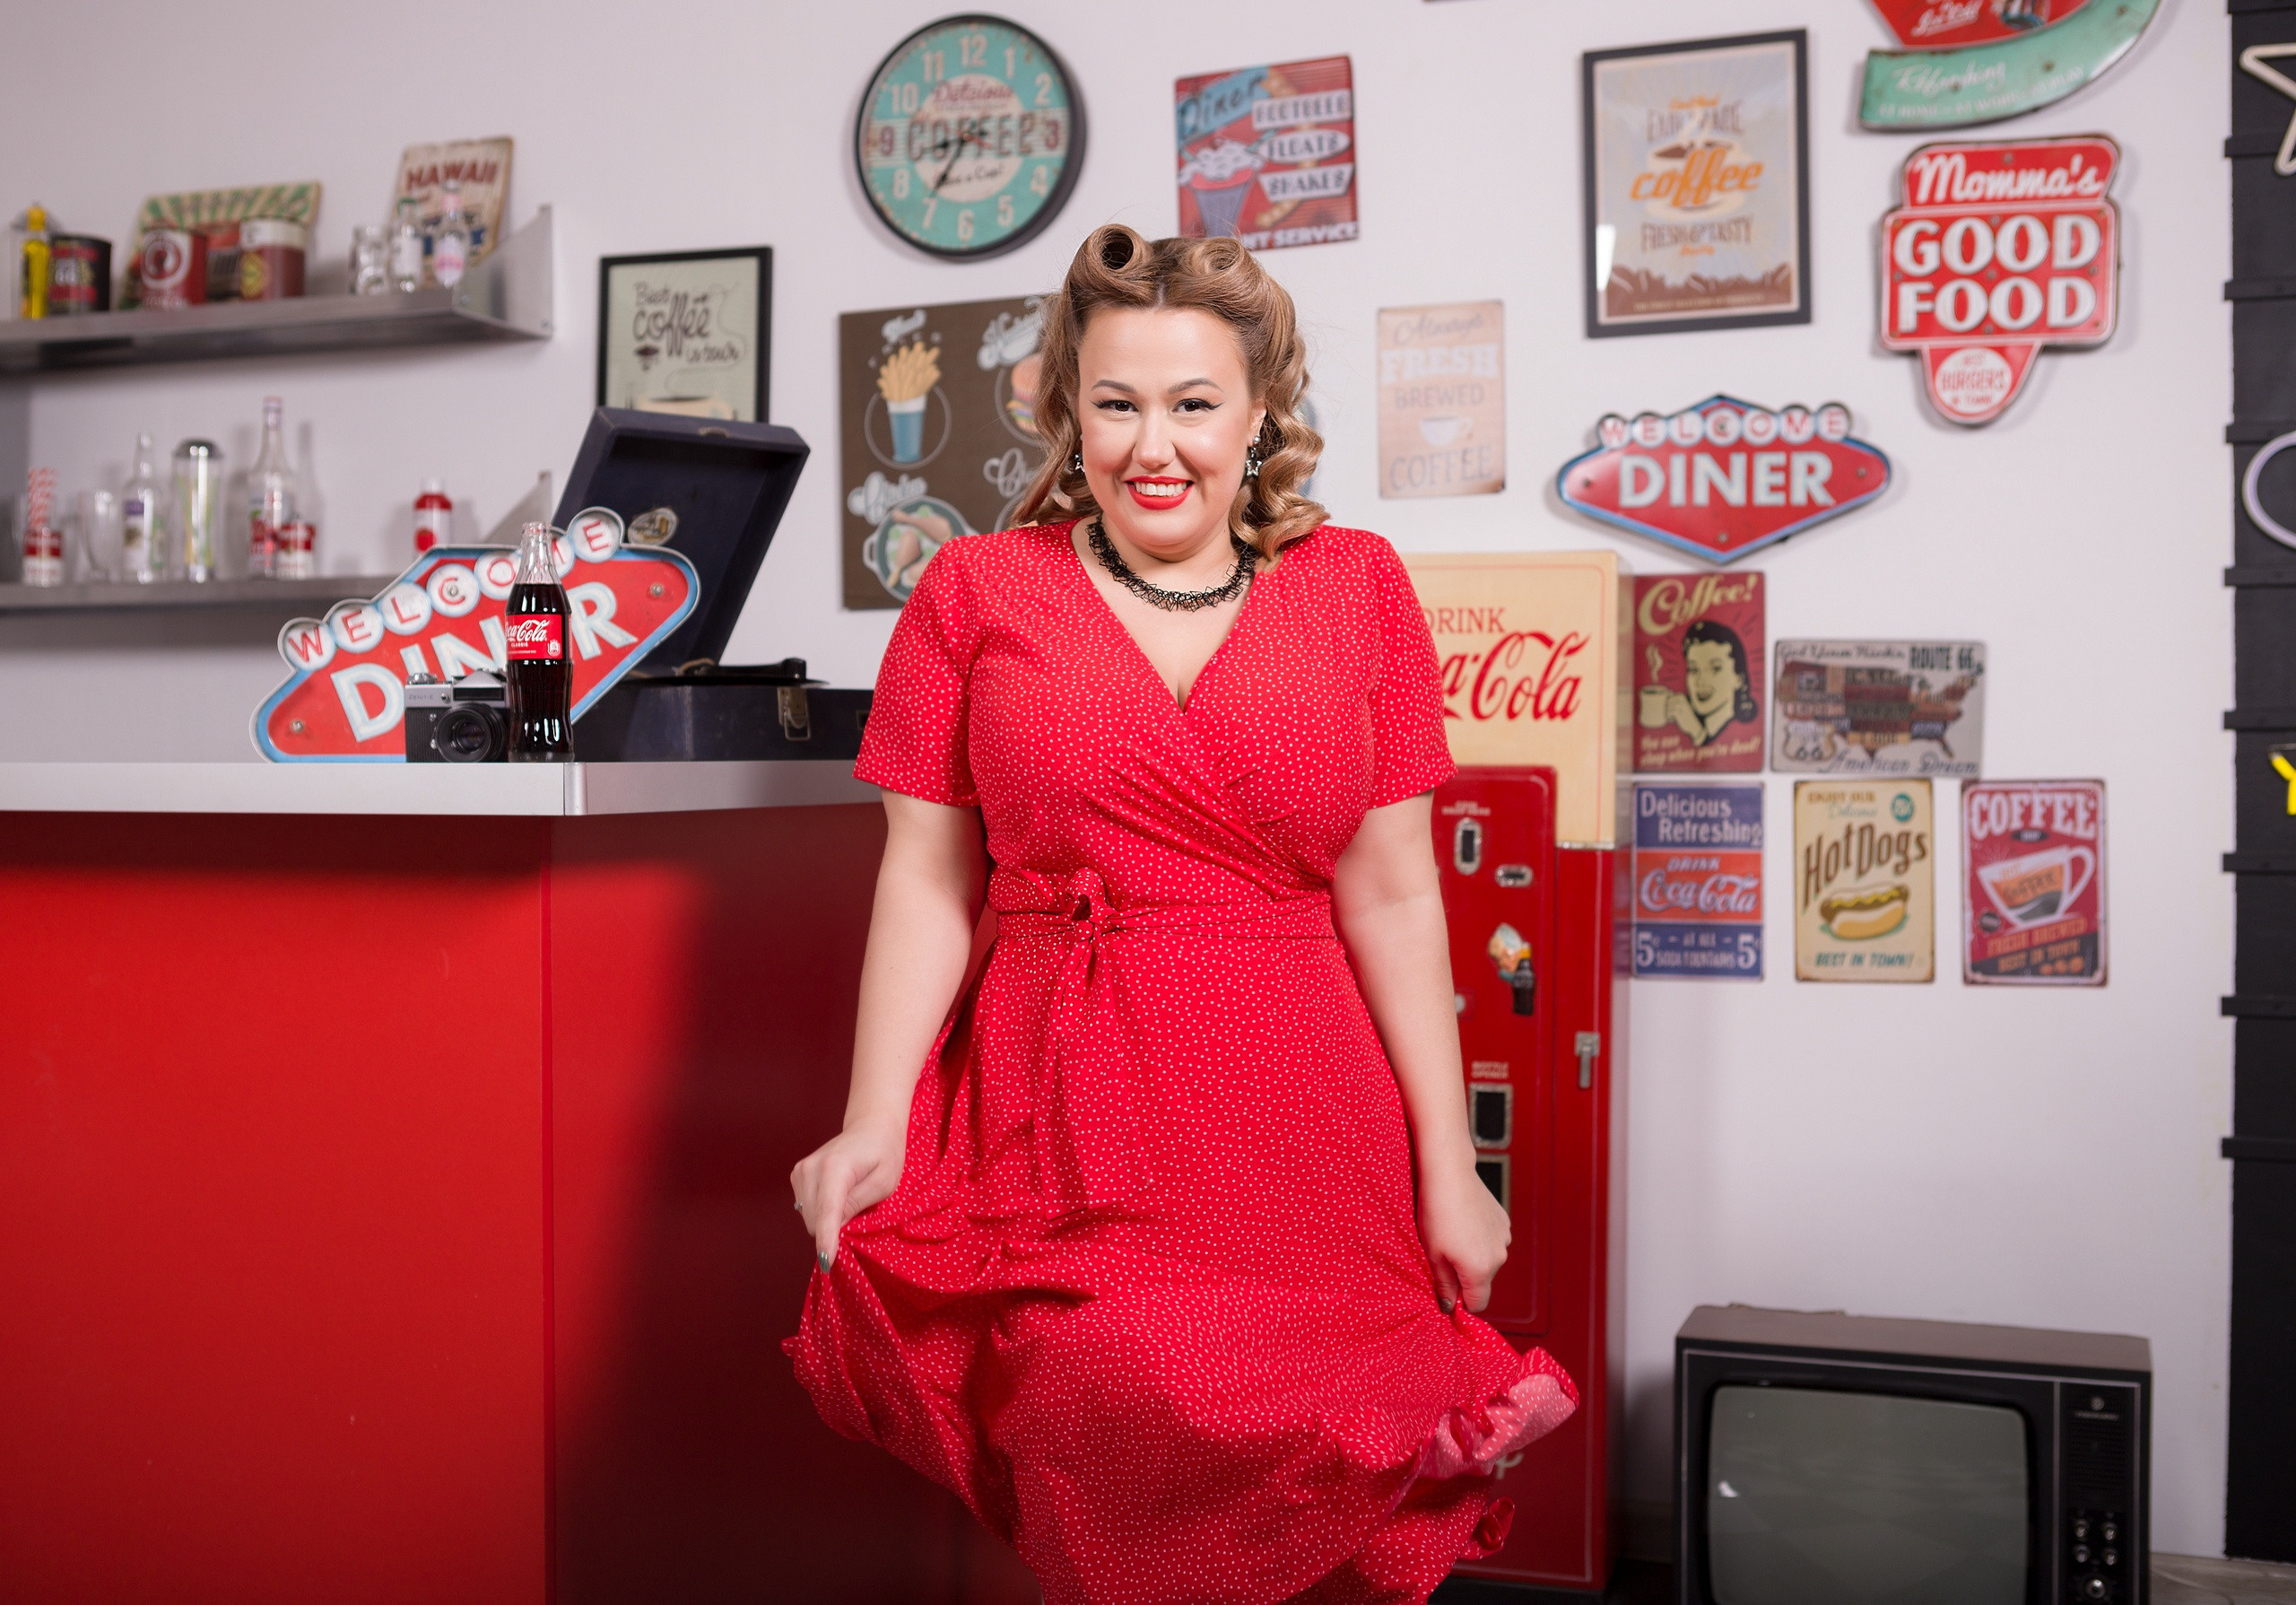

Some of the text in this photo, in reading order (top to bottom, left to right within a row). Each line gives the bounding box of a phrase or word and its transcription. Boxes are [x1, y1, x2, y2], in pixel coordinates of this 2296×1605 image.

[922, 50, 944, 82] 11
[960, 34, 987, 68] 12
[1004, 47, 1016, 79] 1
[891, 83, 918, 115] 10
[1035, 73, 1052, 105] 2
[1178, 74, 1265, 141] Diner
[880, 126, 895, 156] 9
[907, 111, 1036, 162] COFFEE
[1044, 118, 1060, 152] 3
[1268, 134, 1338, 158] FLOATS
[892, 169, 910, 200] 8
[1030, 165, 1048, 197] 4
[1268, 170, 1345, 196] SHAKES
[1631, 145, 1764, 208] coffee
[1913, 153, 2104, 204] Momma's
[922, 197, 938, 230] 7
[957, 209, 974, 241] 6
[997, 195, 1013, 227] 5
[1892, 214, 2102, 277] GOOD
[1897, 275, 2098, 333] FOOD
[632, 292, 711, 357] coffee
[1380, 343, 1500, 387] FRESH
[1941, 369, 2005, 392] BURGERS
[1395, 383, 1485, 411] BREWED
[1602, 410, 1845, 441] WELCOME
[1390, 445, 1493, 491] COFFEE
[1618, 450, 1836, 508] DINER
[1638, 573, 1759, 635] Coffee!
[330, 581, 639, 743] DINR
[1639, 790, 1732, 818] Delicious
[1971, 791, 2097, 842] COFFEE
[1658, 817, 1762, 847] Refreshing
[1666, 857, 1721, 872] DRINK
[1803, 821, 1928, 912] Hot Dogs
[1815, 952, 1847, 967] BEST
